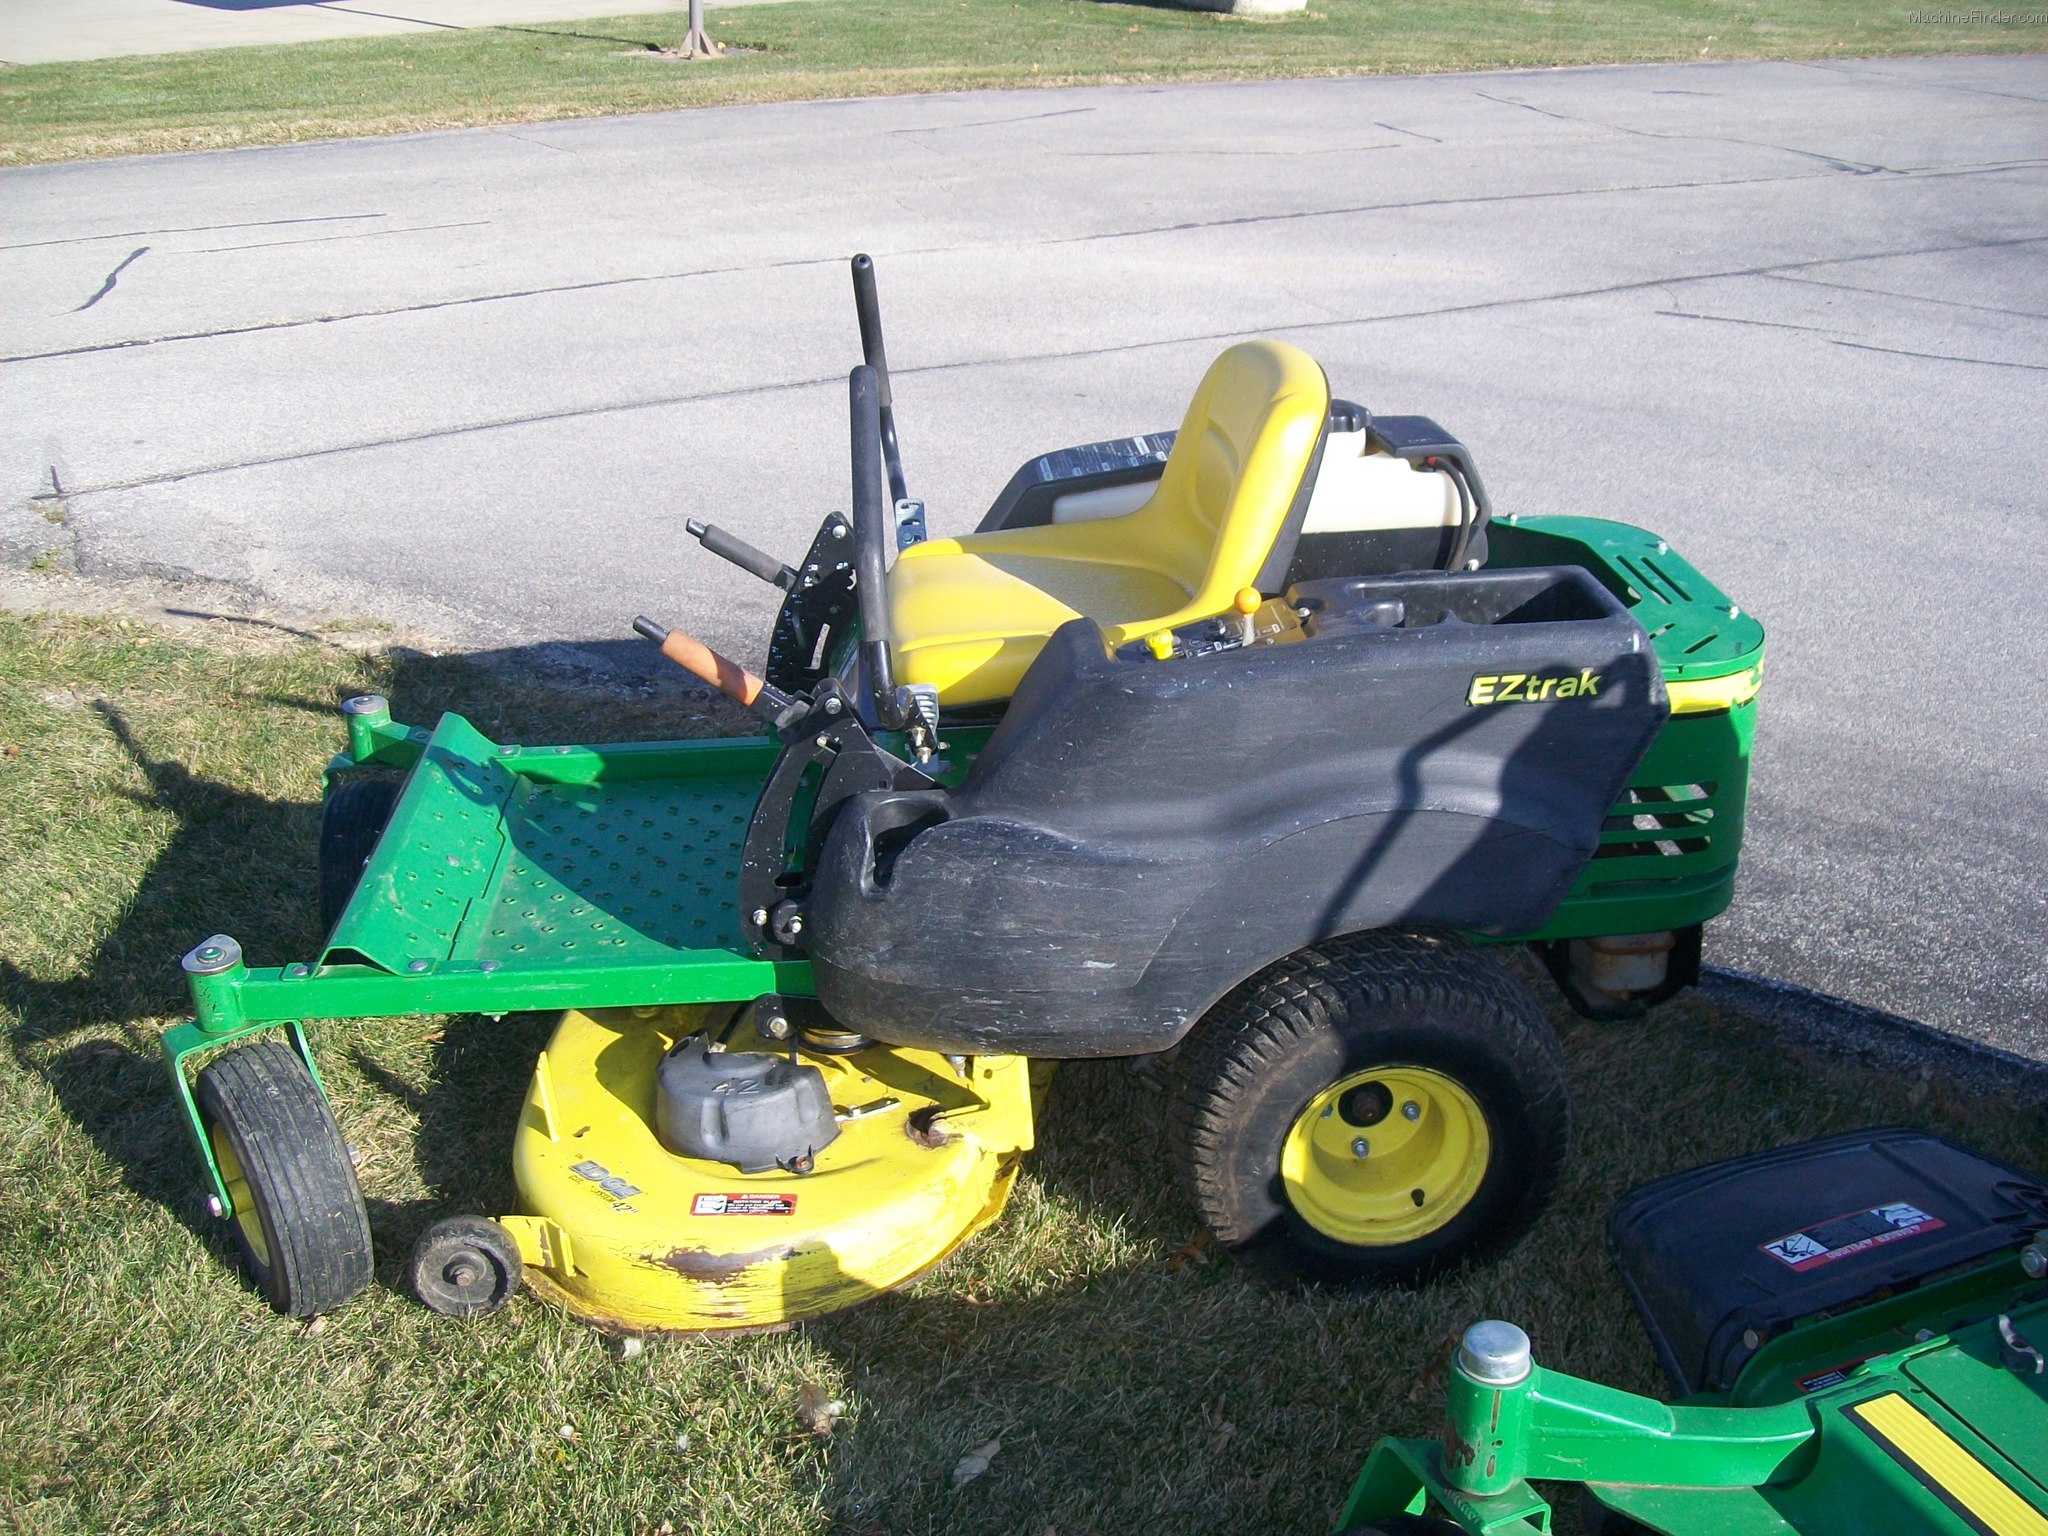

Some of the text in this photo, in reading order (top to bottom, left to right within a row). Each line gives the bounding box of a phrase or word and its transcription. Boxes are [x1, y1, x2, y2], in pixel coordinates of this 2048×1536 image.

[1468, 667, 1601, 706] EZtrak
[712, 1079, 760, 1096] 42
[568, 1160, 643, 1200] EDGE
